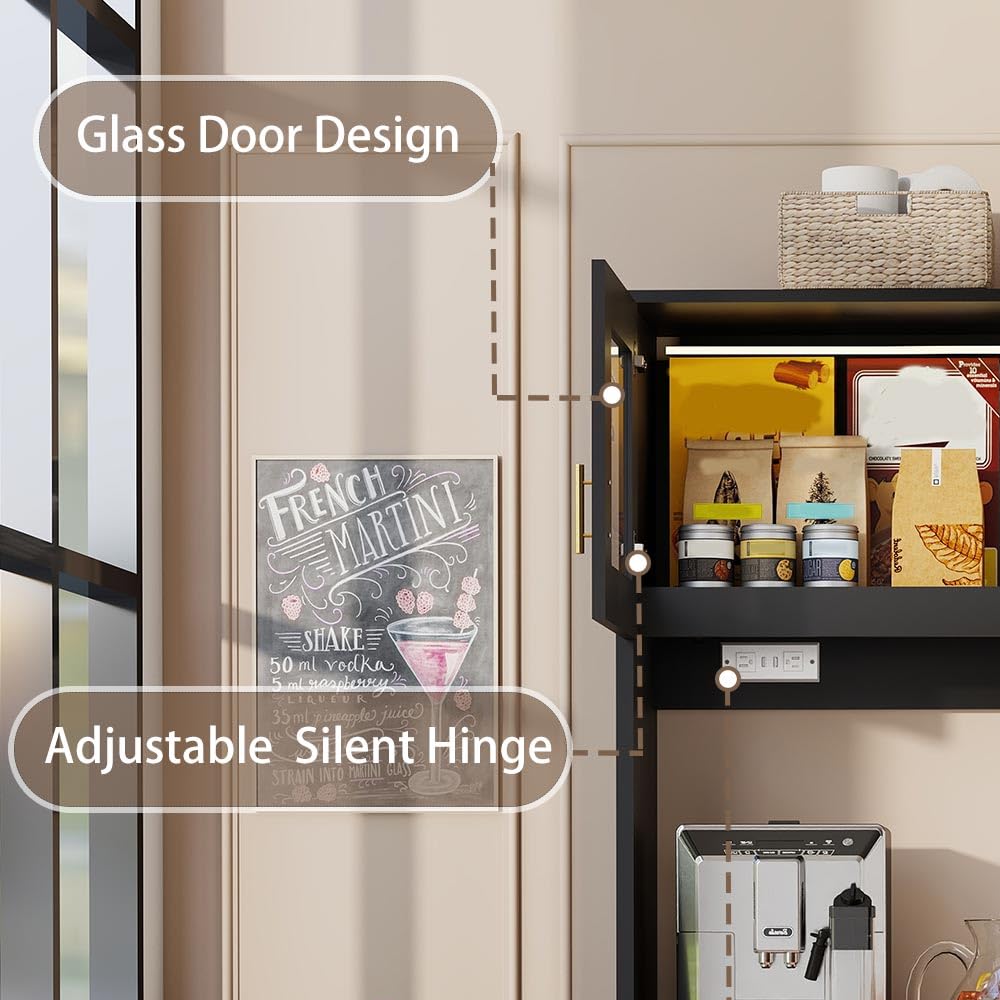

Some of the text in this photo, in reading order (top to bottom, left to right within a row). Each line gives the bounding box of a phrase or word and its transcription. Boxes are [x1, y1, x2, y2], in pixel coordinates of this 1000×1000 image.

[259, 464, 387, 542] FRENCH
[325, 479, 463, 577] MARTINI
[301, 625, 365, 652] SHAKE
[269, 654, 395, 675] 50 ml vodka
[272, 675, 396, 697] 5 ml raspberry
